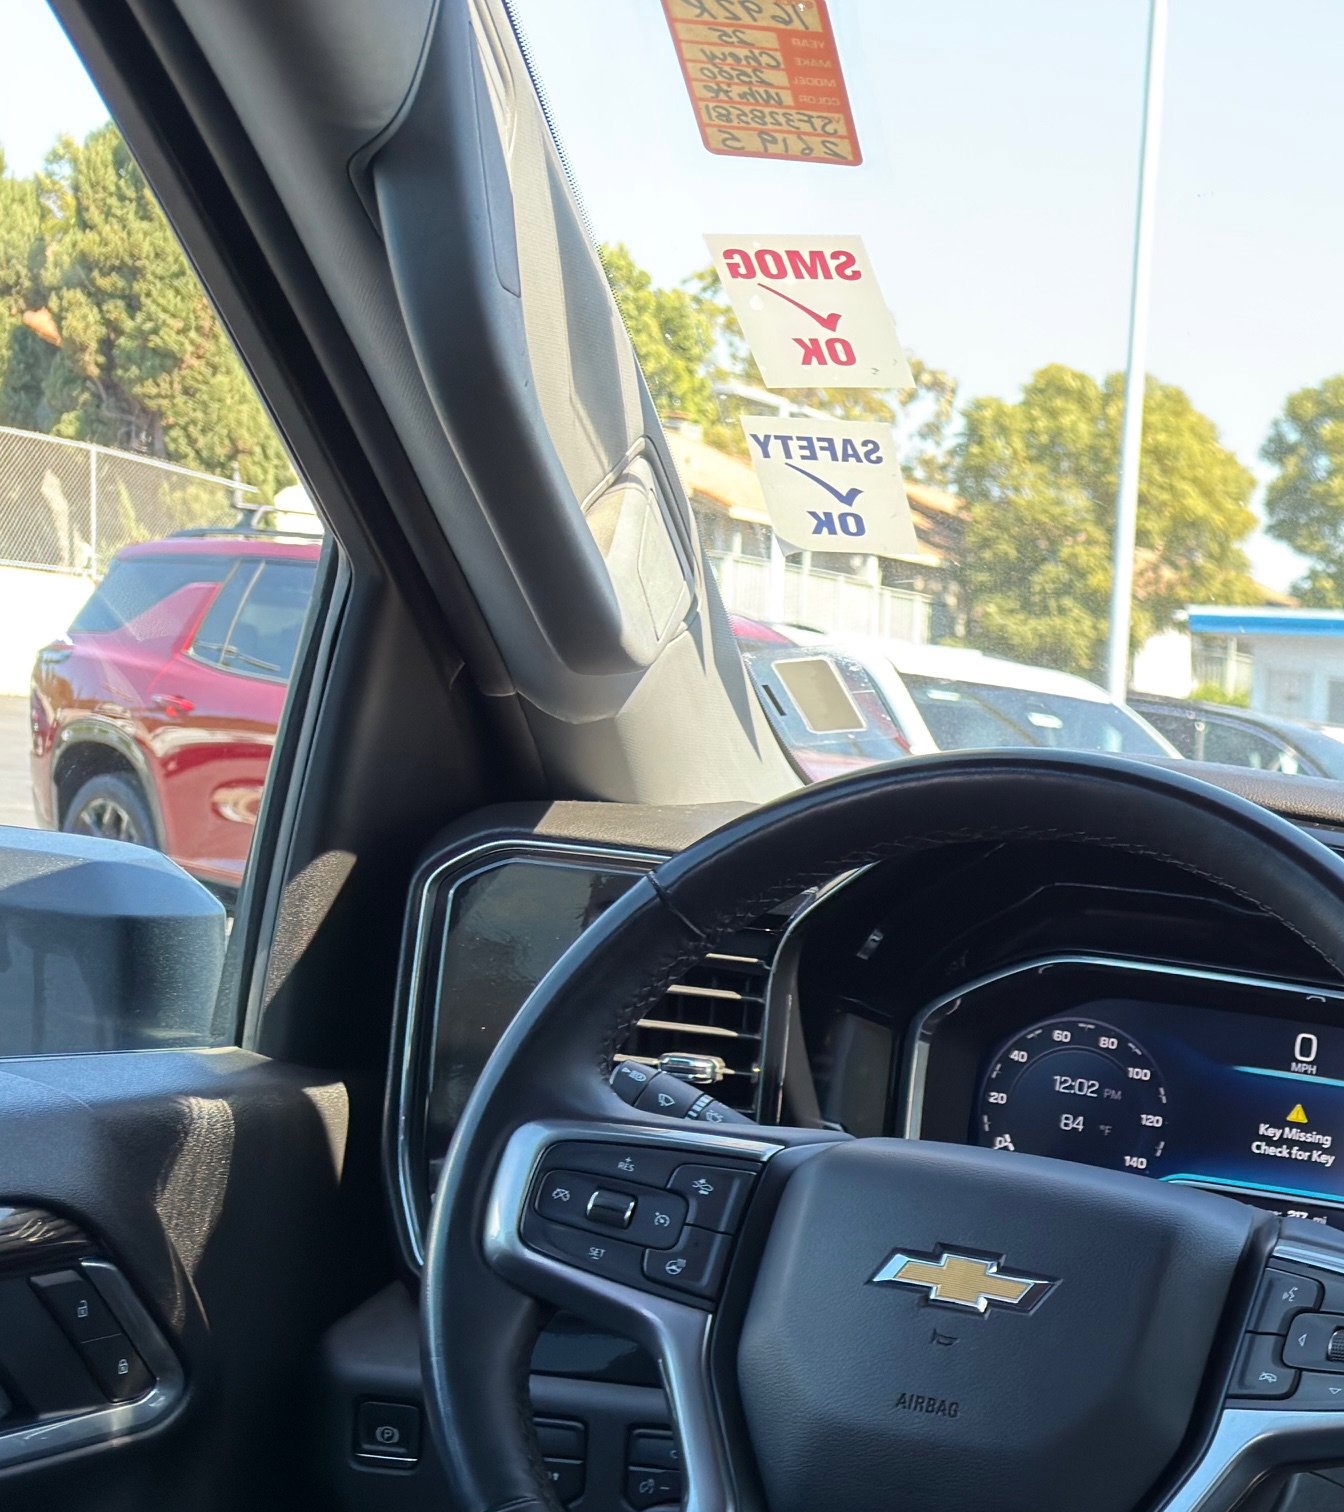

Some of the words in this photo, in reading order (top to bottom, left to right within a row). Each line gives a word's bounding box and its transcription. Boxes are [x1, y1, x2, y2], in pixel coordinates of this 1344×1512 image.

[1052, 1029, 1072, 1043] 60
[1099, 1036, 1119, 1050] 80
[1295, 1032, 1318, 1062] 0
[1010, 1049, 1028, 1063] 40
[1127, 1067, 1151, 1082] 100
[1290, 1061, 1317, 1075] MPH
[1052, 1074, 1100, 1098] 12:02
[1104, 1087, 1122, 1101] PM
[988, 1091, 1007, 1104] 20
[1060, 1113, 1084, 1132] 84
[1140, 1113, 1163, 1128] 120
[1258, 1122, 1282, 1142] Key
[1283, 1125, 1332, 1148] Missing
[1251, 1140, 1285, 1159] Check
[1286, 1145, 1302, 1161] for
[1304, 1148, 1335, 1168] Key
[617, 1161, 635, 1173] RES
[1124, 1155, 1148, 1170] 140
[589, 1246, 605, 1259] SET
[895, 1392, 960, 1419] AIRBAG
